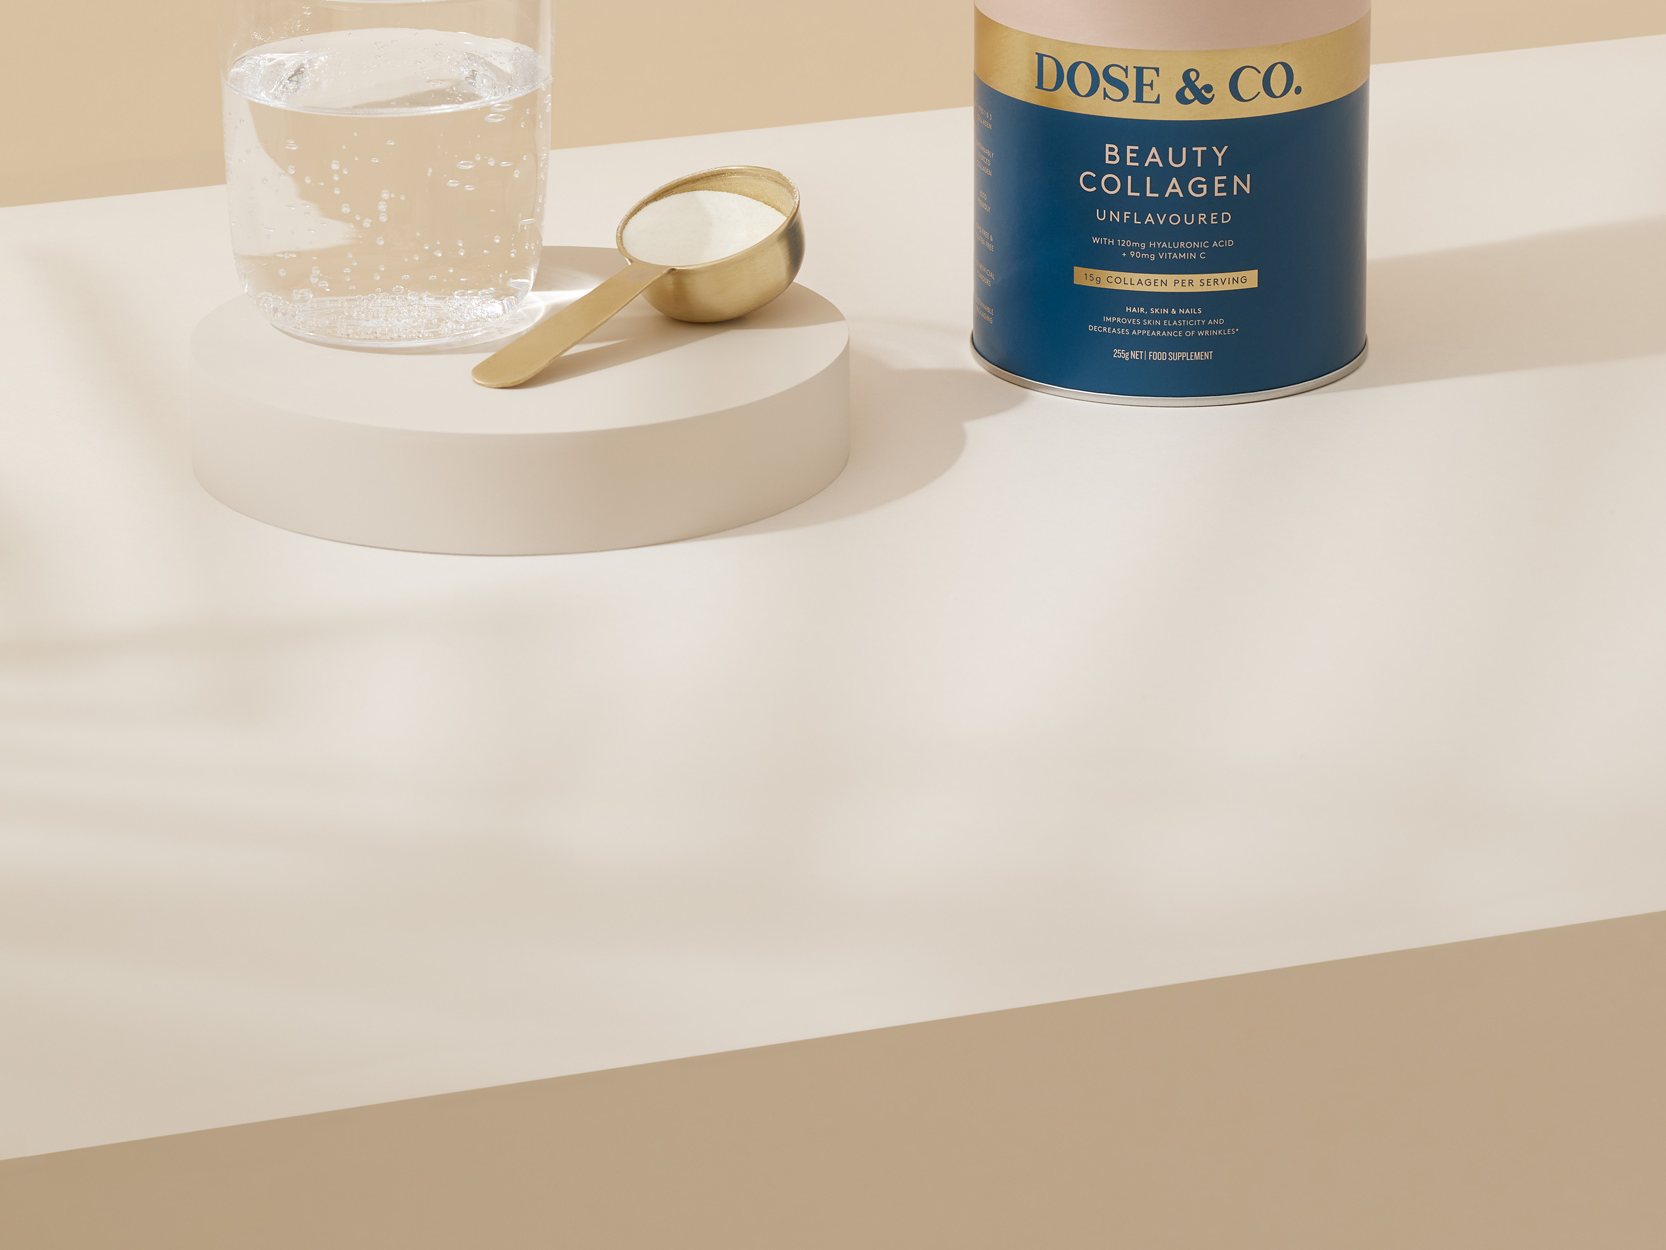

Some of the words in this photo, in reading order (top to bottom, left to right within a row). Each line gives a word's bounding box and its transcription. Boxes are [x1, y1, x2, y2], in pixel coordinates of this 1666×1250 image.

[1034, 51, 1161, 105] DOSE
[1174, 67, 1216, 106] &
[1227, 60, 1303, 104] CO.
[1104, 142, 1230, 169] BEAUTY
[1078, 170, 1253, 199] COLLAGEN
[1095, 208, 1233, 226] UNFLAVOURED
[1091, 236, 1115, 247] WITH
[1117, 238, 1146, 250] 120mg
[1149, 240, 1210, 249] HYALURONIC
[1211, 238, 1235, 249] ACID
[1129, 250, 1156, 261] 90mg
[1158, 252, 1197, 260] VITAMIN
[1199, 251, 1207, 260] C
[1084, 272, 1102, 285] 15g
[1106, 275, 1169, 288] COLLAGEN
[1173, 278, 1195, 288] PER
[1199, 275, 1249, 287] SERVING
[1125, 306, 1148, 315] HAIR,
[1150, 307, 1169, 315] SKIN
[1178, 307, 1203, 315] NAILS
[1103, 316, 1141, 326] IMPROVES
[1163, 319, 1206, 327] ELASTICITY
[1207, 318, 1225, 326] AND
[1088, 325, 1130, 336] DECREASES
[1131, 329, 1183, 338] APPEARANCE
[1113, 348, 1130, 360] 255g
[1130, 350, 1143, 361] NET
[1148, 351, 1167, 362] FOOD
[1168, 350, 1214, 362] SUPPLEMENT
